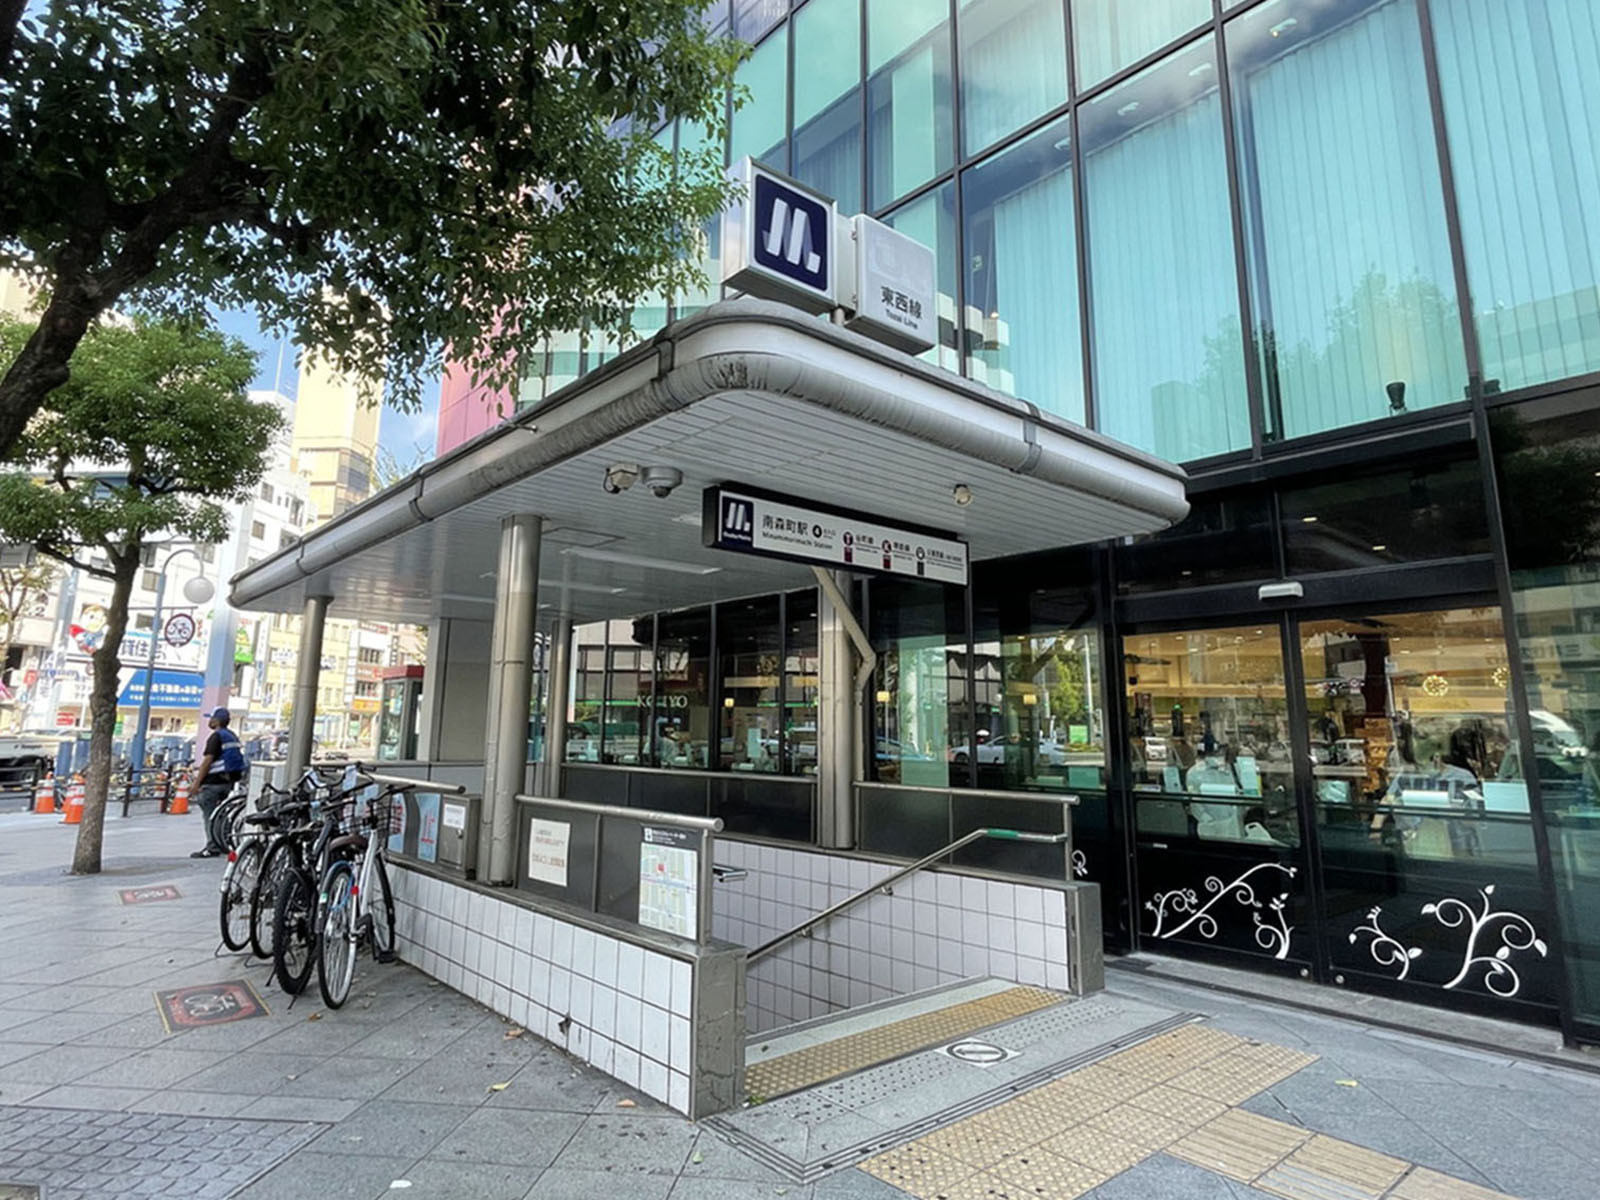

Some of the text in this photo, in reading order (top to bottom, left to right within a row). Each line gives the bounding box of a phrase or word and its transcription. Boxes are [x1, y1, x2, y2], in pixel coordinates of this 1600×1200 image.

[881, 286, 922, 318] 東西線
[885, 309, 918, 330] Tozai Line
[762, 514, 808, 536] 南森町駅
